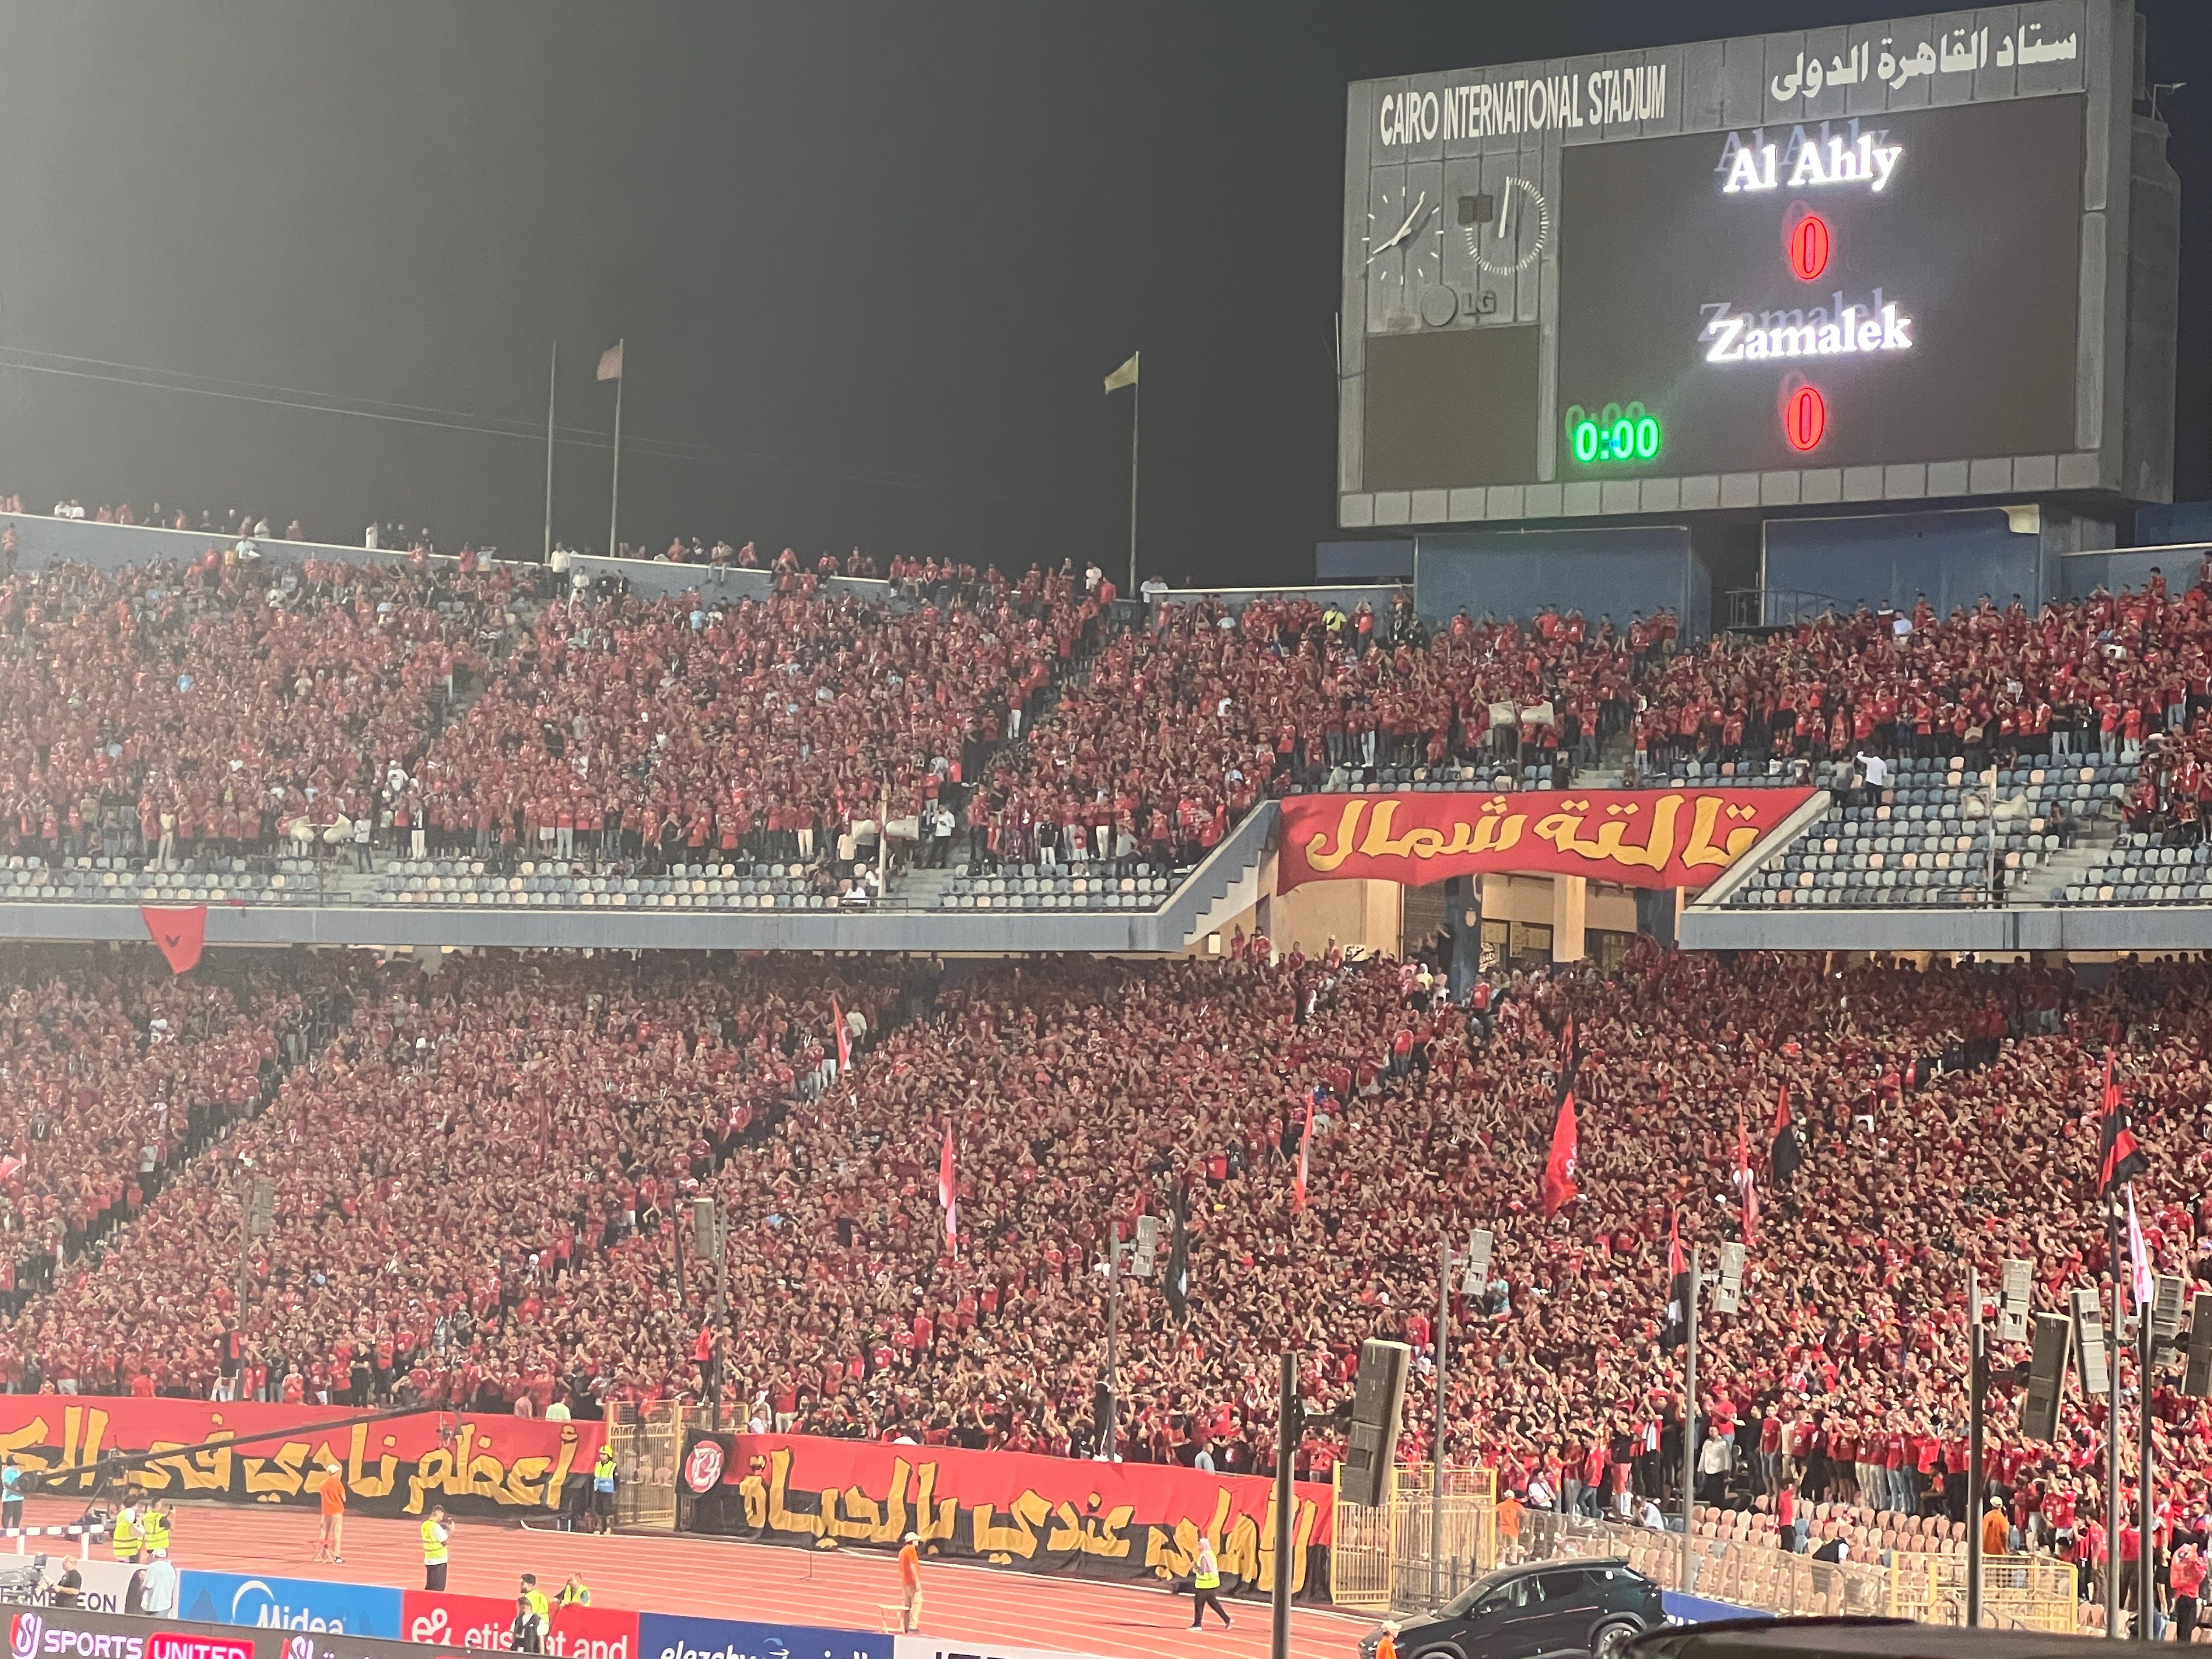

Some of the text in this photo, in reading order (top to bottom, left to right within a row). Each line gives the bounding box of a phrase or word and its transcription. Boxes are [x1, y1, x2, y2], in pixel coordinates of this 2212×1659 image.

[1877, 26, 1988, 89] القاهرة
[1996, 23, 2076, 67] ستاد
[1380, 64, 1666, 146] CAIRO INTERNATIONAL STADIUM
[1723, 133, 1904, 193] Al Ahly
[1791, 217, 1829, 280] 0
[1706, 303, 1913, 362] Zamalek
[1574, 416, 1661, 463] 0:00
[1787, 387, 1825, 450] 0
[1305, 794, 1528, 871] شمال
[44, 1629, 143, 1659] SPORTS
[256, 1603, 344, 1634] Midea
[573, 1634, 628, 1659] and
